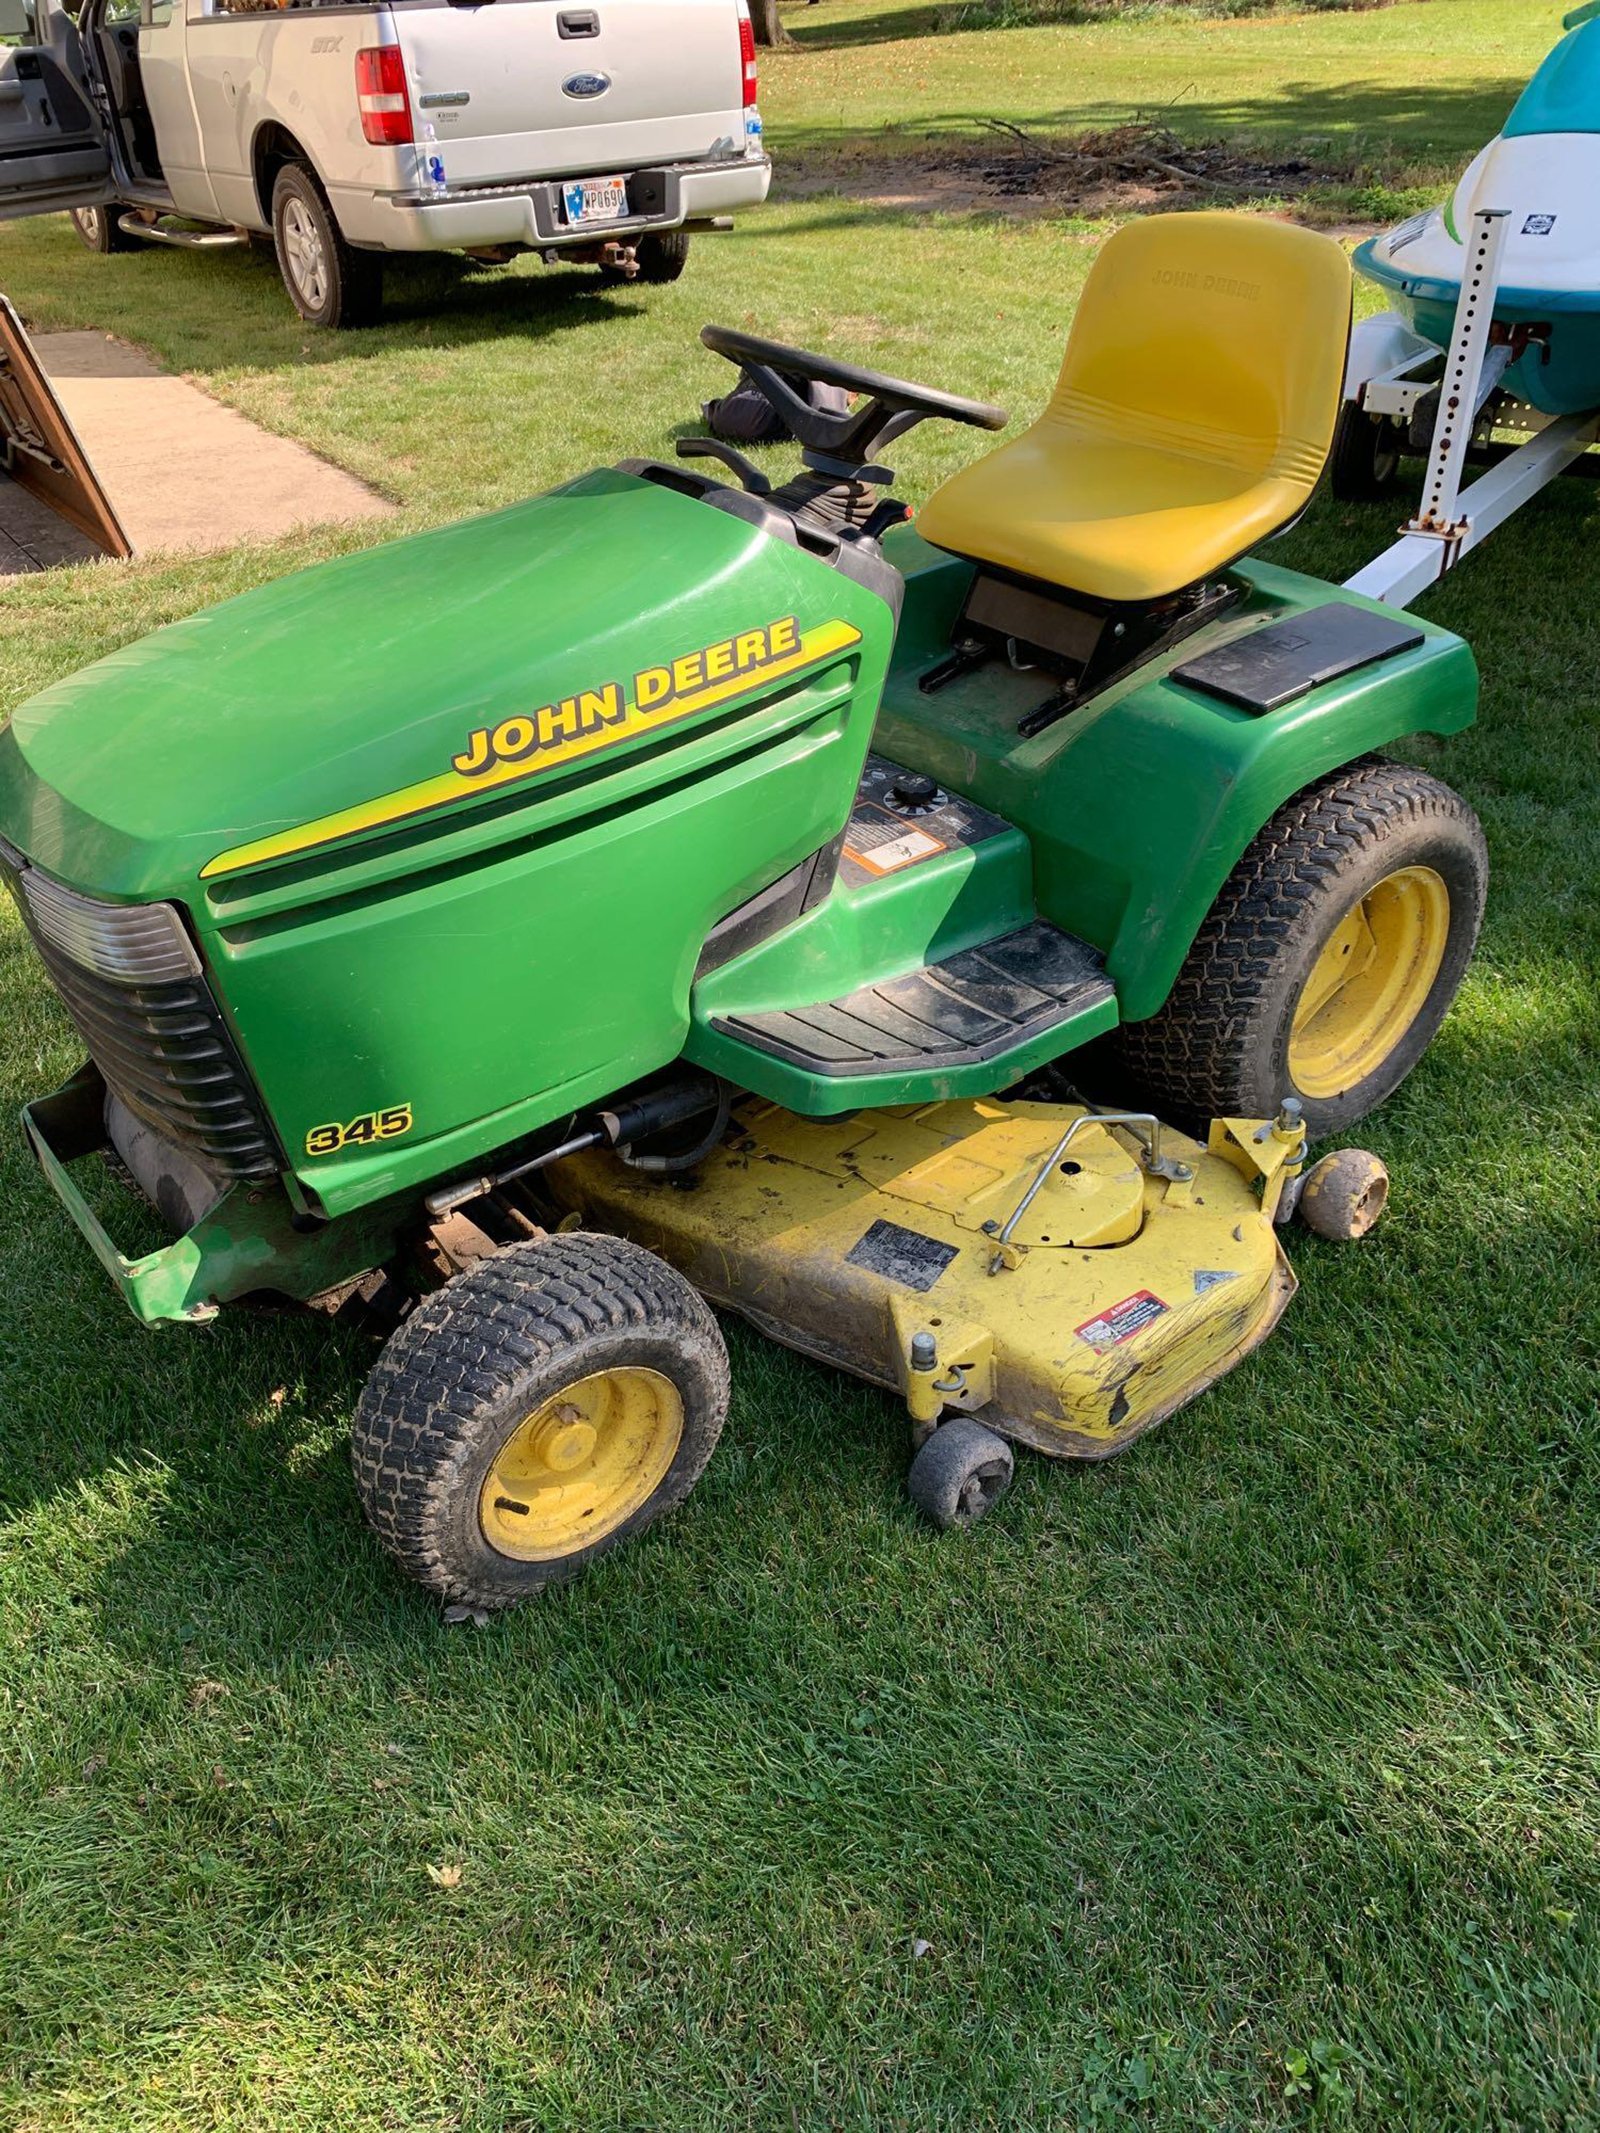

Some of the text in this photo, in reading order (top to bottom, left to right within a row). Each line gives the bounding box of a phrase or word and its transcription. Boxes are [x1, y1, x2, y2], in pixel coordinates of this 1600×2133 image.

[573, 78, 599, 92] Ford
[1151, 269, 1261, 302] JOHN DEERE
[452, 615, 801, 776] JOHN DEERE
[306, 1102, 413, 1156] 345
